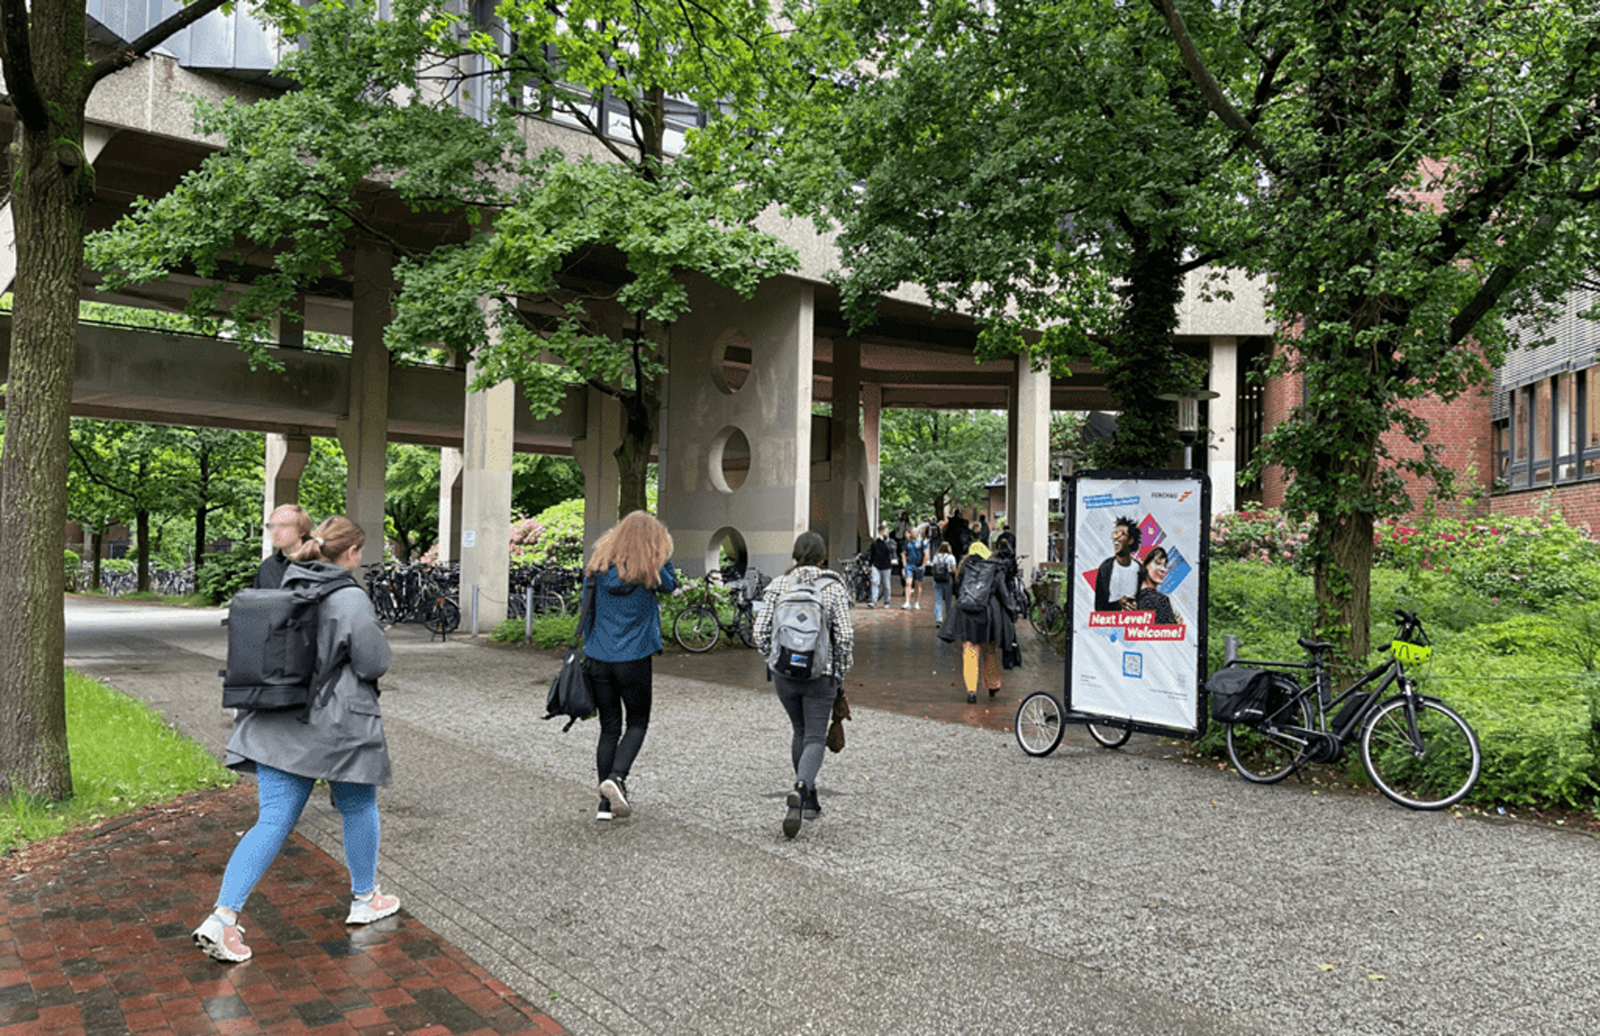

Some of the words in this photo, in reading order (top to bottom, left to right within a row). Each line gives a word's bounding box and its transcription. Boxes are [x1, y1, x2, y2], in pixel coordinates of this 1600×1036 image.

[1091, 614, 1116, 625] Next
[1118, 612, 1152, 625] Level?
[1127, 626, 1183, 638] Welcome!
